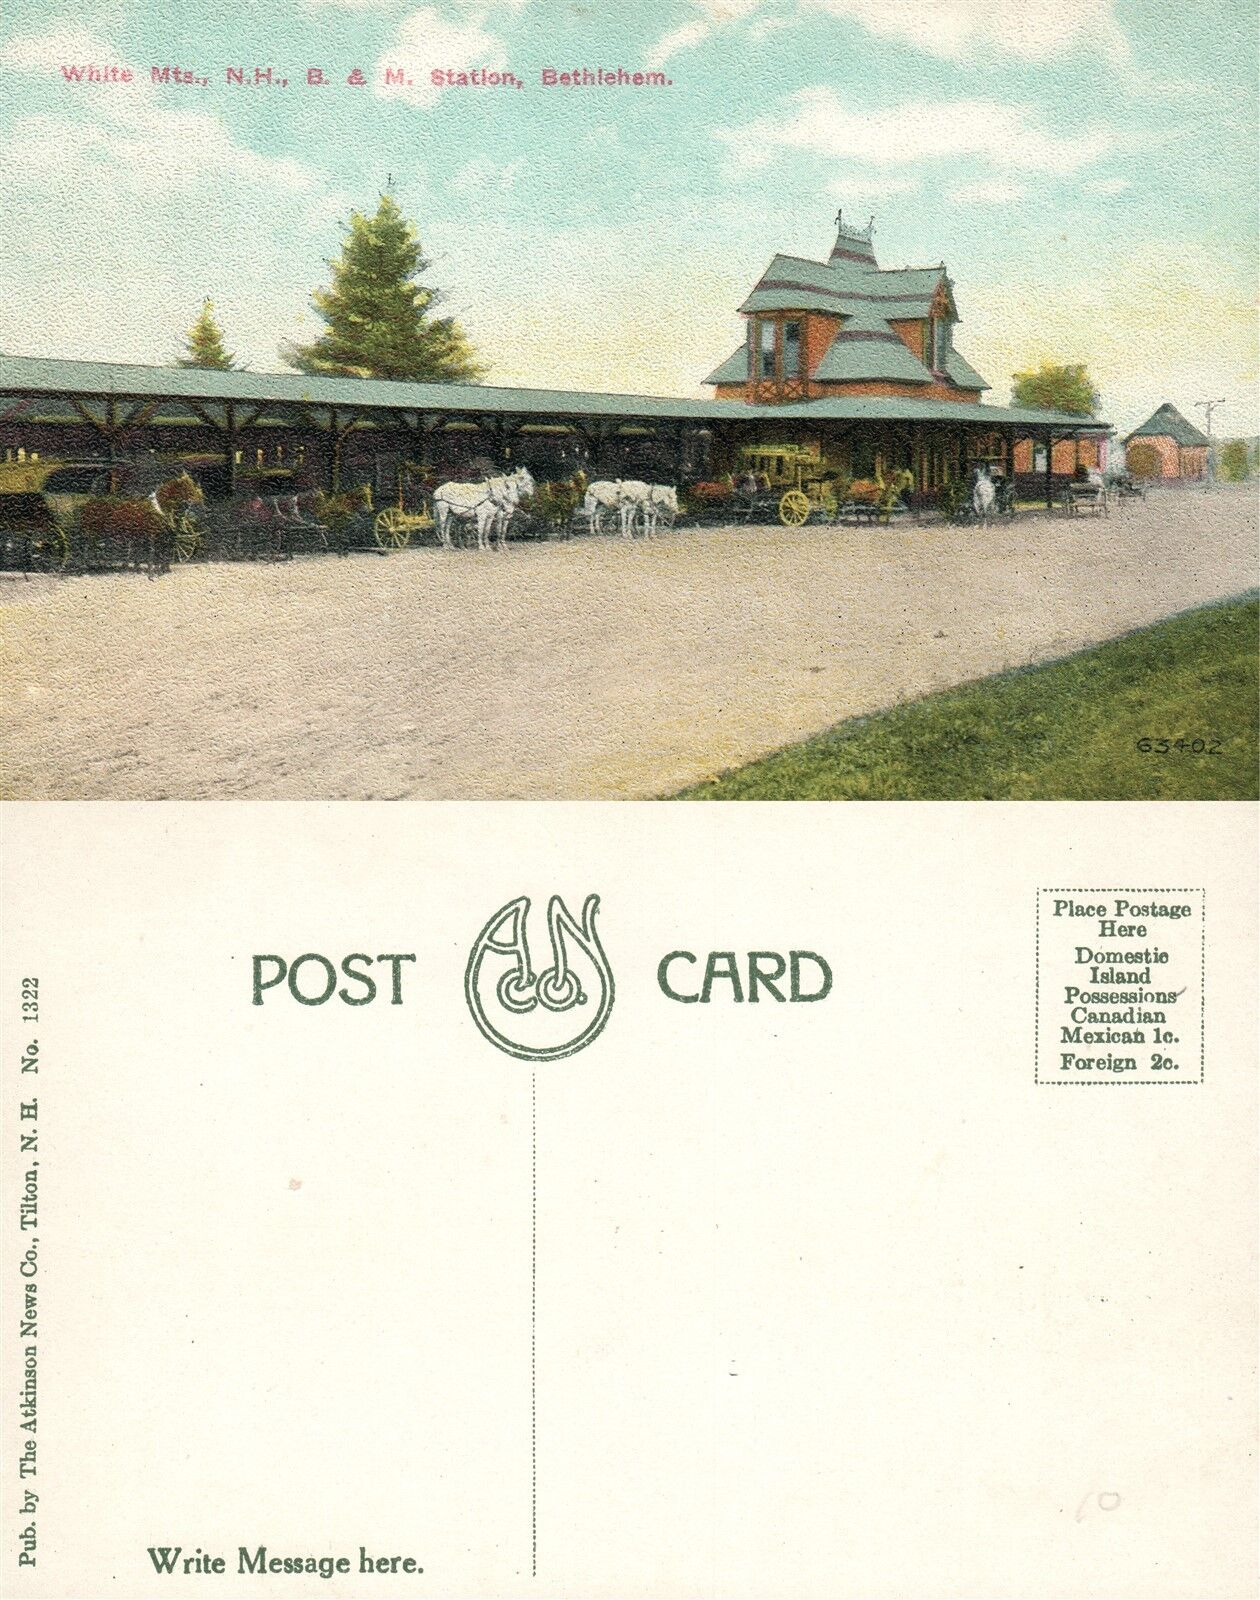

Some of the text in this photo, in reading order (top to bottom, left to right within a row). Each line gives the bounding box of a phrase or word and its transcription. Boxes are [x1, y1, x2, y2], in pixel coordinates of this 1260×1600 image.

[60, 65, 674, 89] White Mts., N.H., B. & M. Station, Bethlehem.
[1136, 737, 1222, 755] 63402
[1053, 899, 1192, 920] Place Postage
[1098, 919, 1147, 937] Here
[1074, 946, 1169, 964] Domestic
[253, 953, 417, 1006] POST
[658, 951, 833, 1004] CARD
[1089, 966, 1151, 984] Island
[1064, 986, 1178, 1004] Possessions
[1070, 1006, 1167, 1024] Canadian
[1060, 1026, 1180, 1044] Mexican 1c.
[1060, 1053, 1180, 1073] Foreign 2c.
[18, 977, 40, 1567] Pub. by The Atkinson News Co., Tilton, N. H. No. 1322
[147, 1546, 424, 1579] Write Message here.
